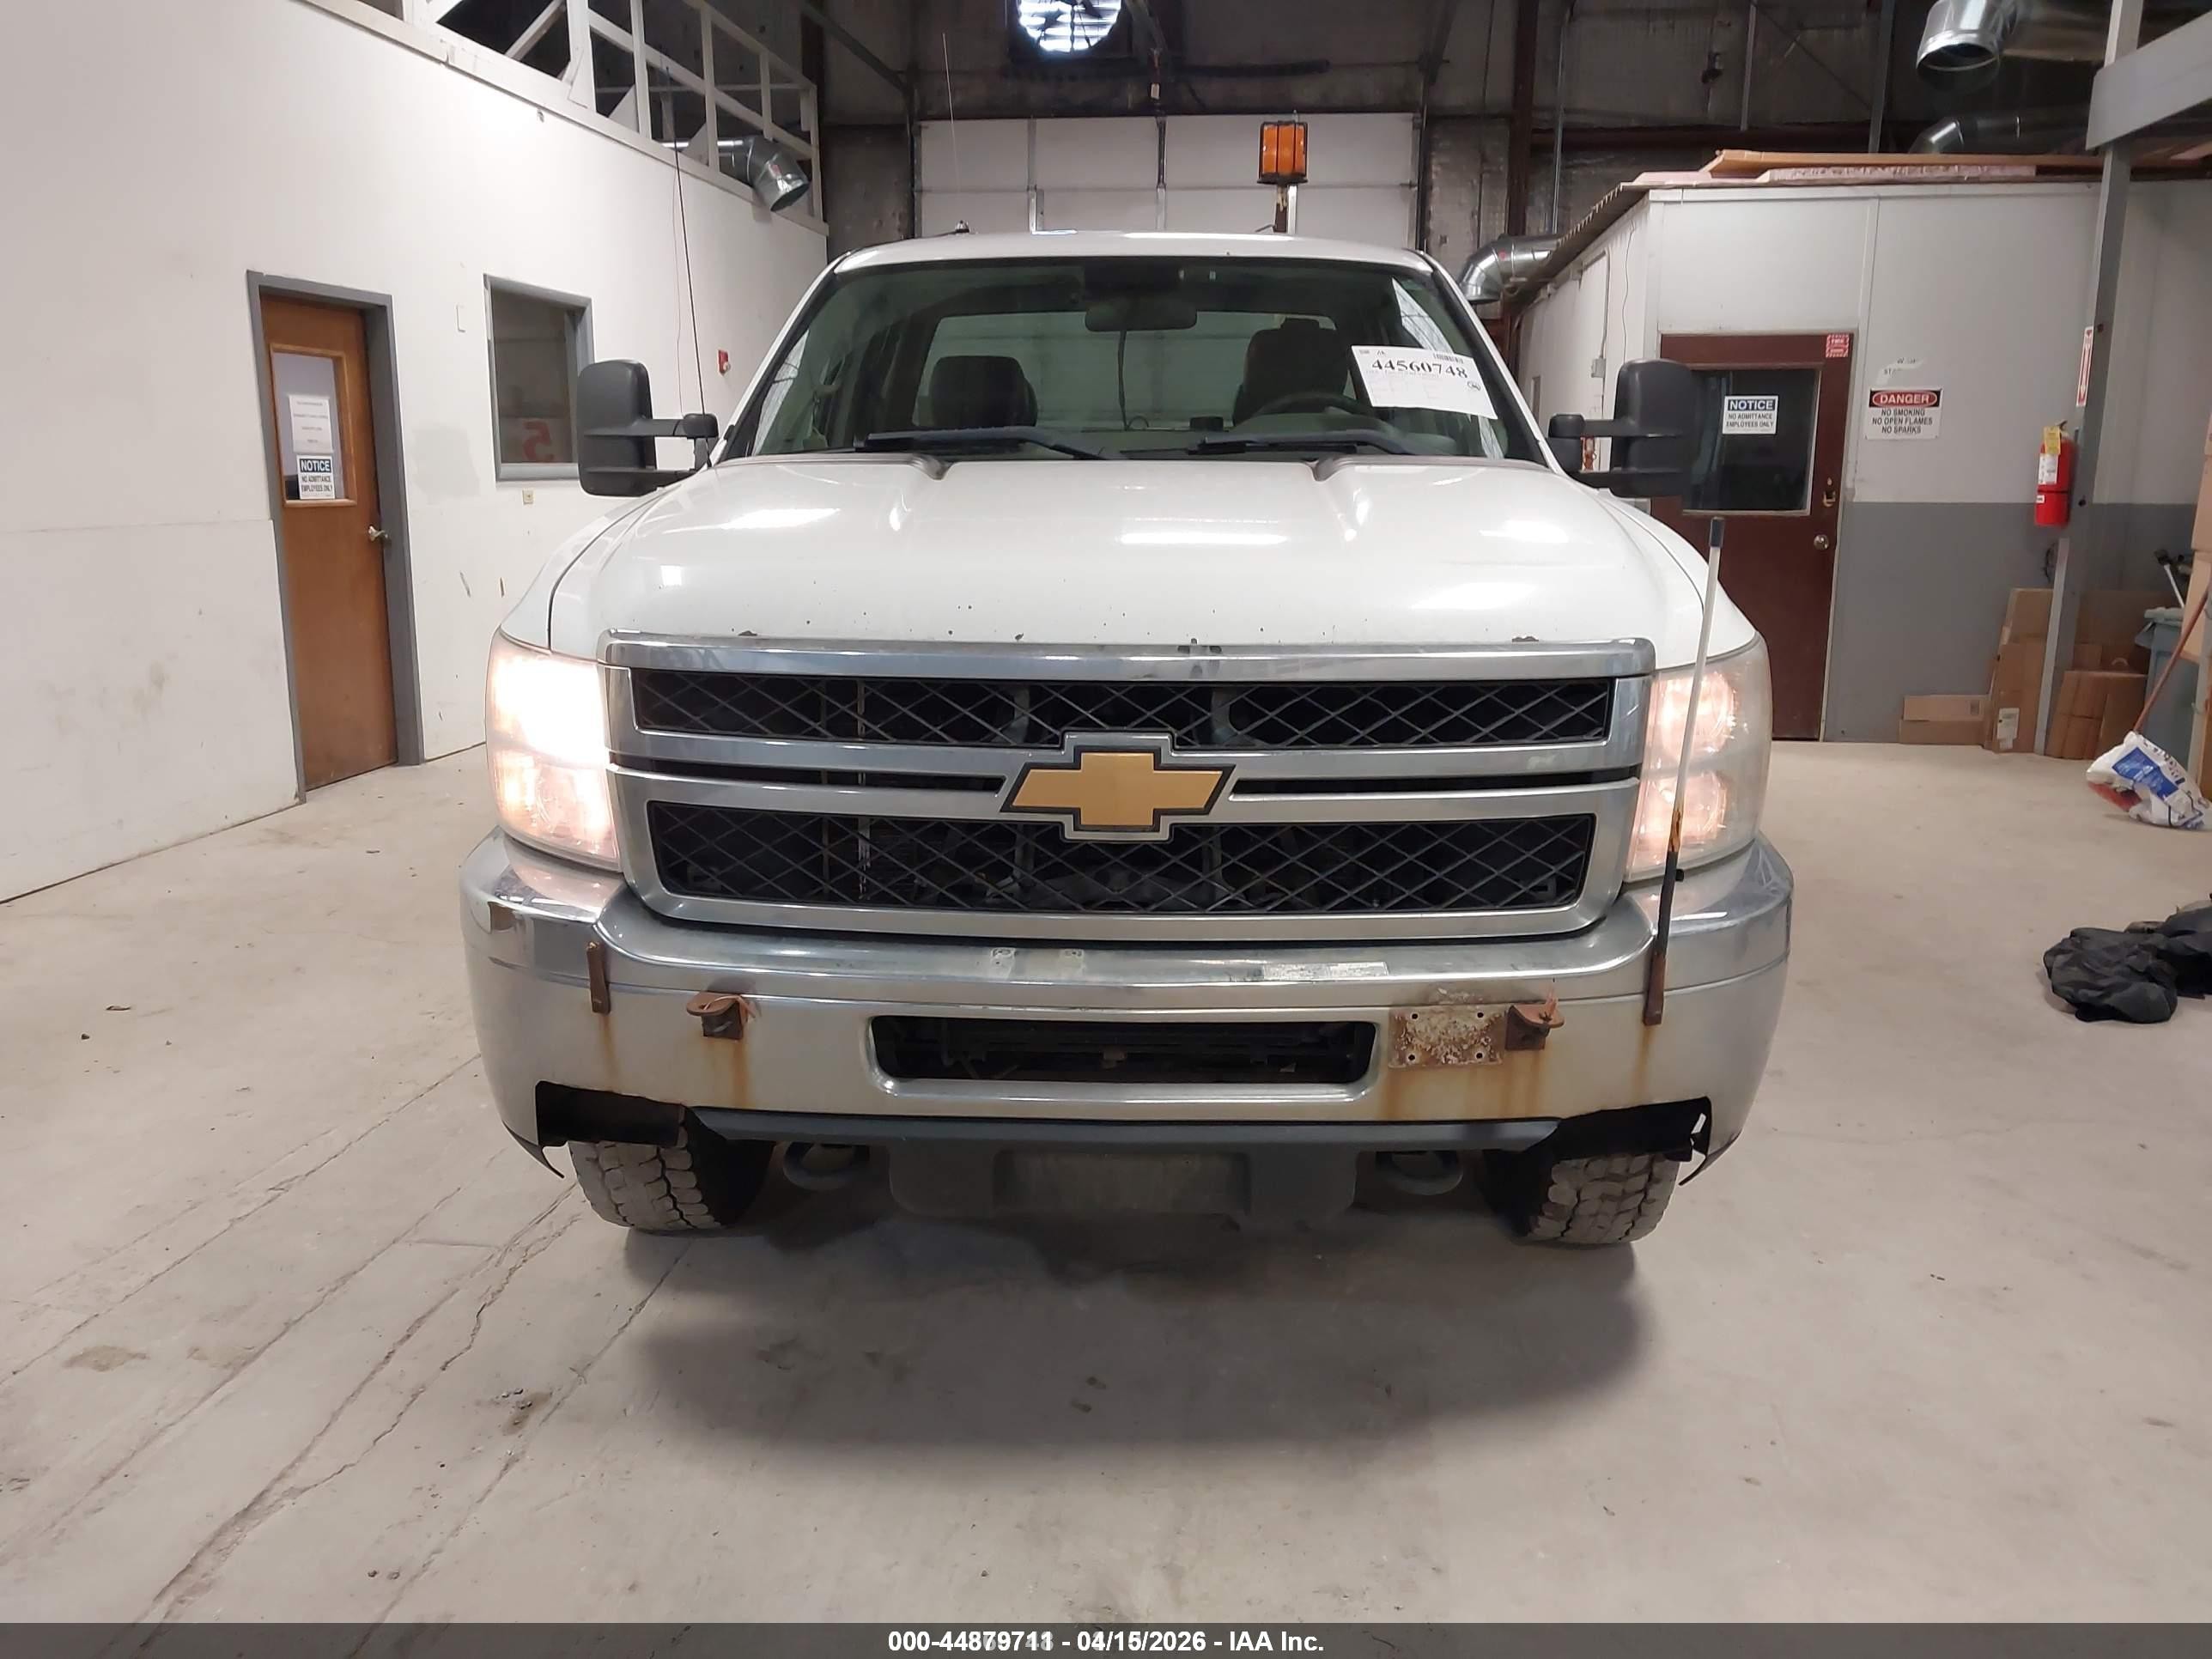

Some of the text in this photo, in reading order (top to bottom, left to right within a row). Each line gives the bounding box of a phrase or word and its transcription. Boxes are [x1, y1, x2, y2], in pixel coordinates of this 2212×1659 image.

[1371, 358, 1468, 379] 44560748
[1880, 394, 1929, 404] DANGER
[1729, 400, 1773, 410] NOTICE
[1905, 416, 1933, 425] FLAMES
[301, 459, 331, 471] NOTICE
